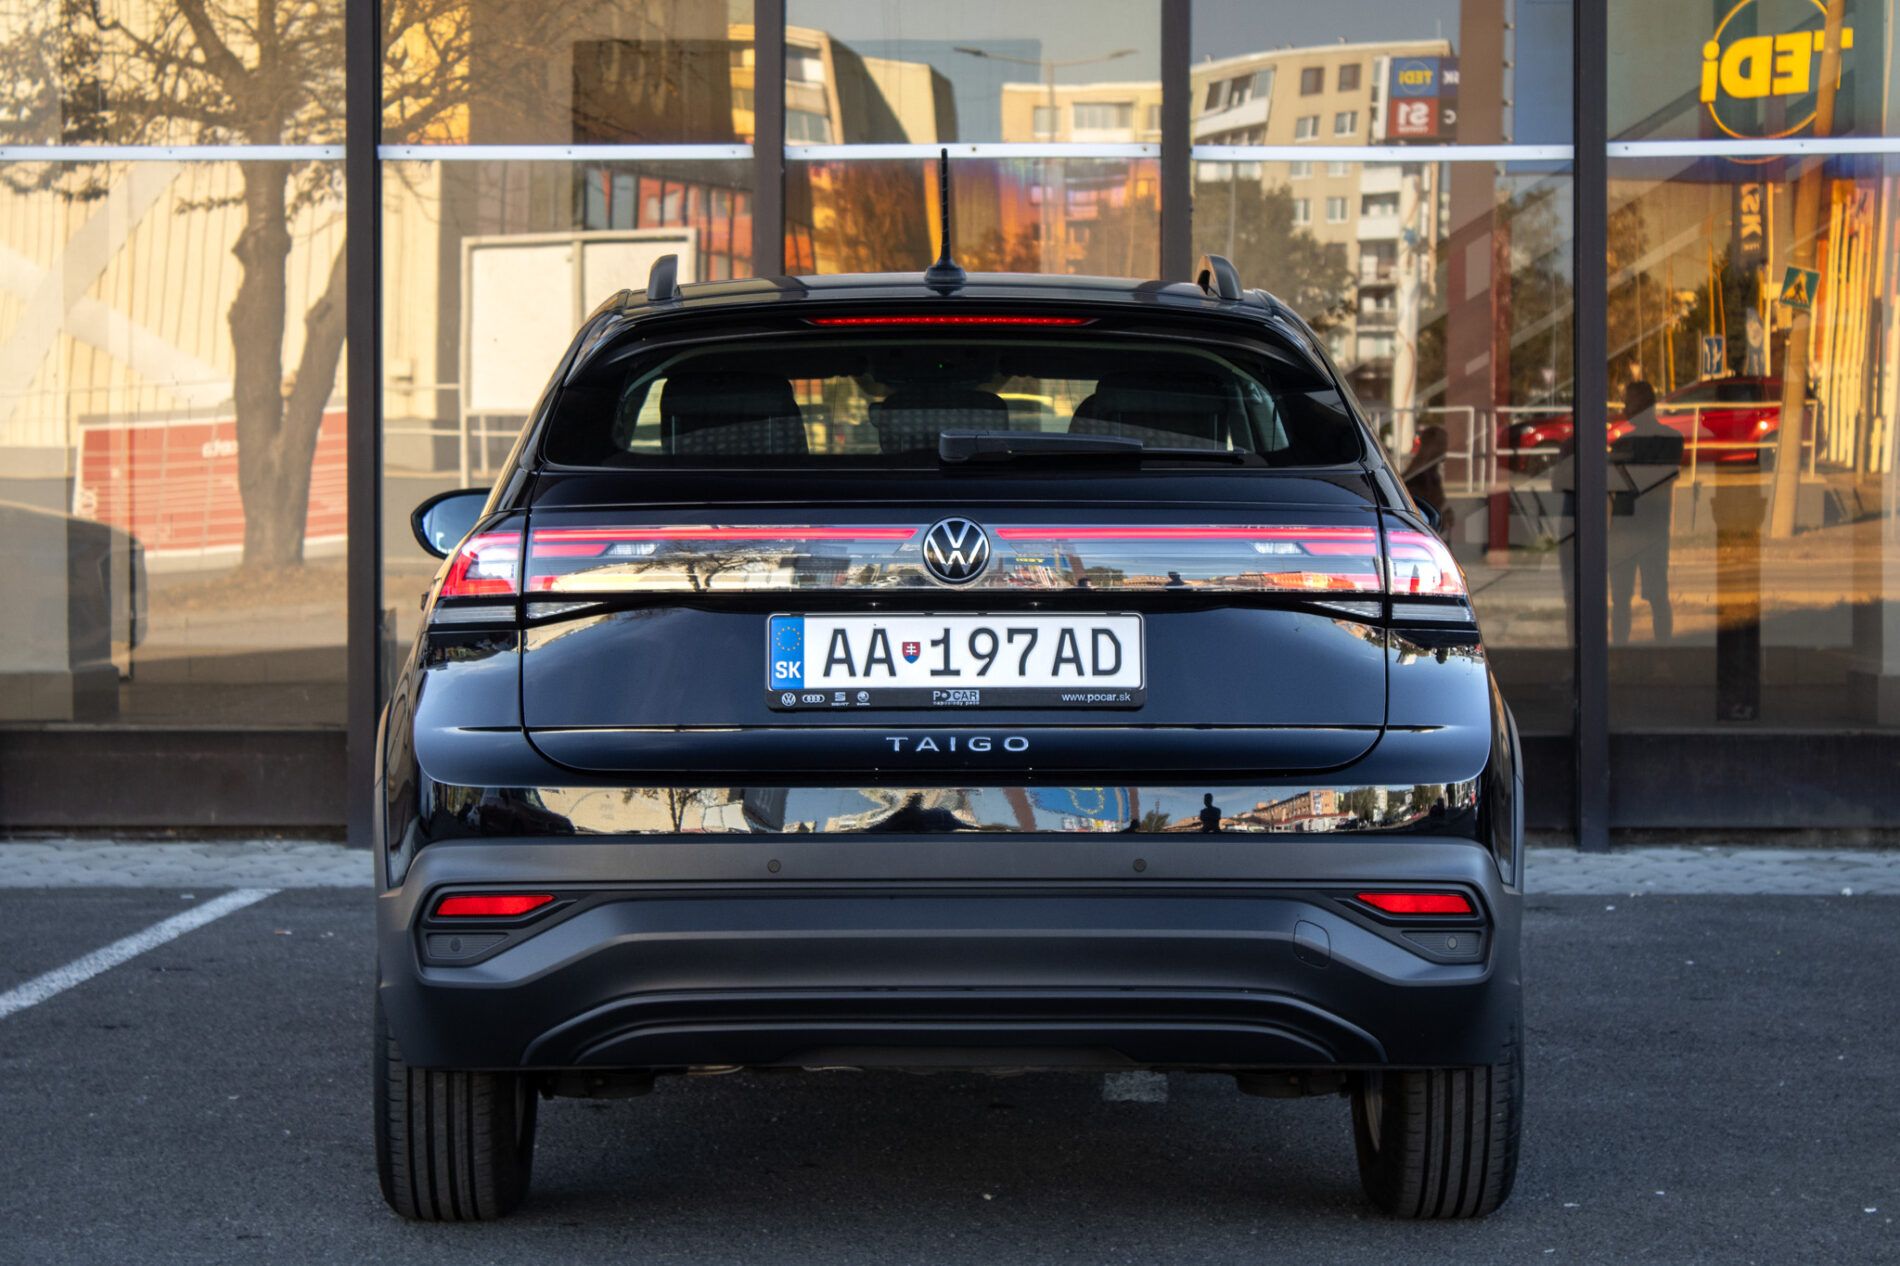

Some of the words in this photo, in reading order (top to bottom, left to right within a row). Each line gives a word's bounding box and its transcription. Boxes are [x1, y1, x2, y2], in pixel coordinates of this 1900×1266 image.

[775, 661, 802, 679] SK
[1061, 692, 1131, 704] www.pocar.sk
[886, 736, 1030, 752] TAIGO
